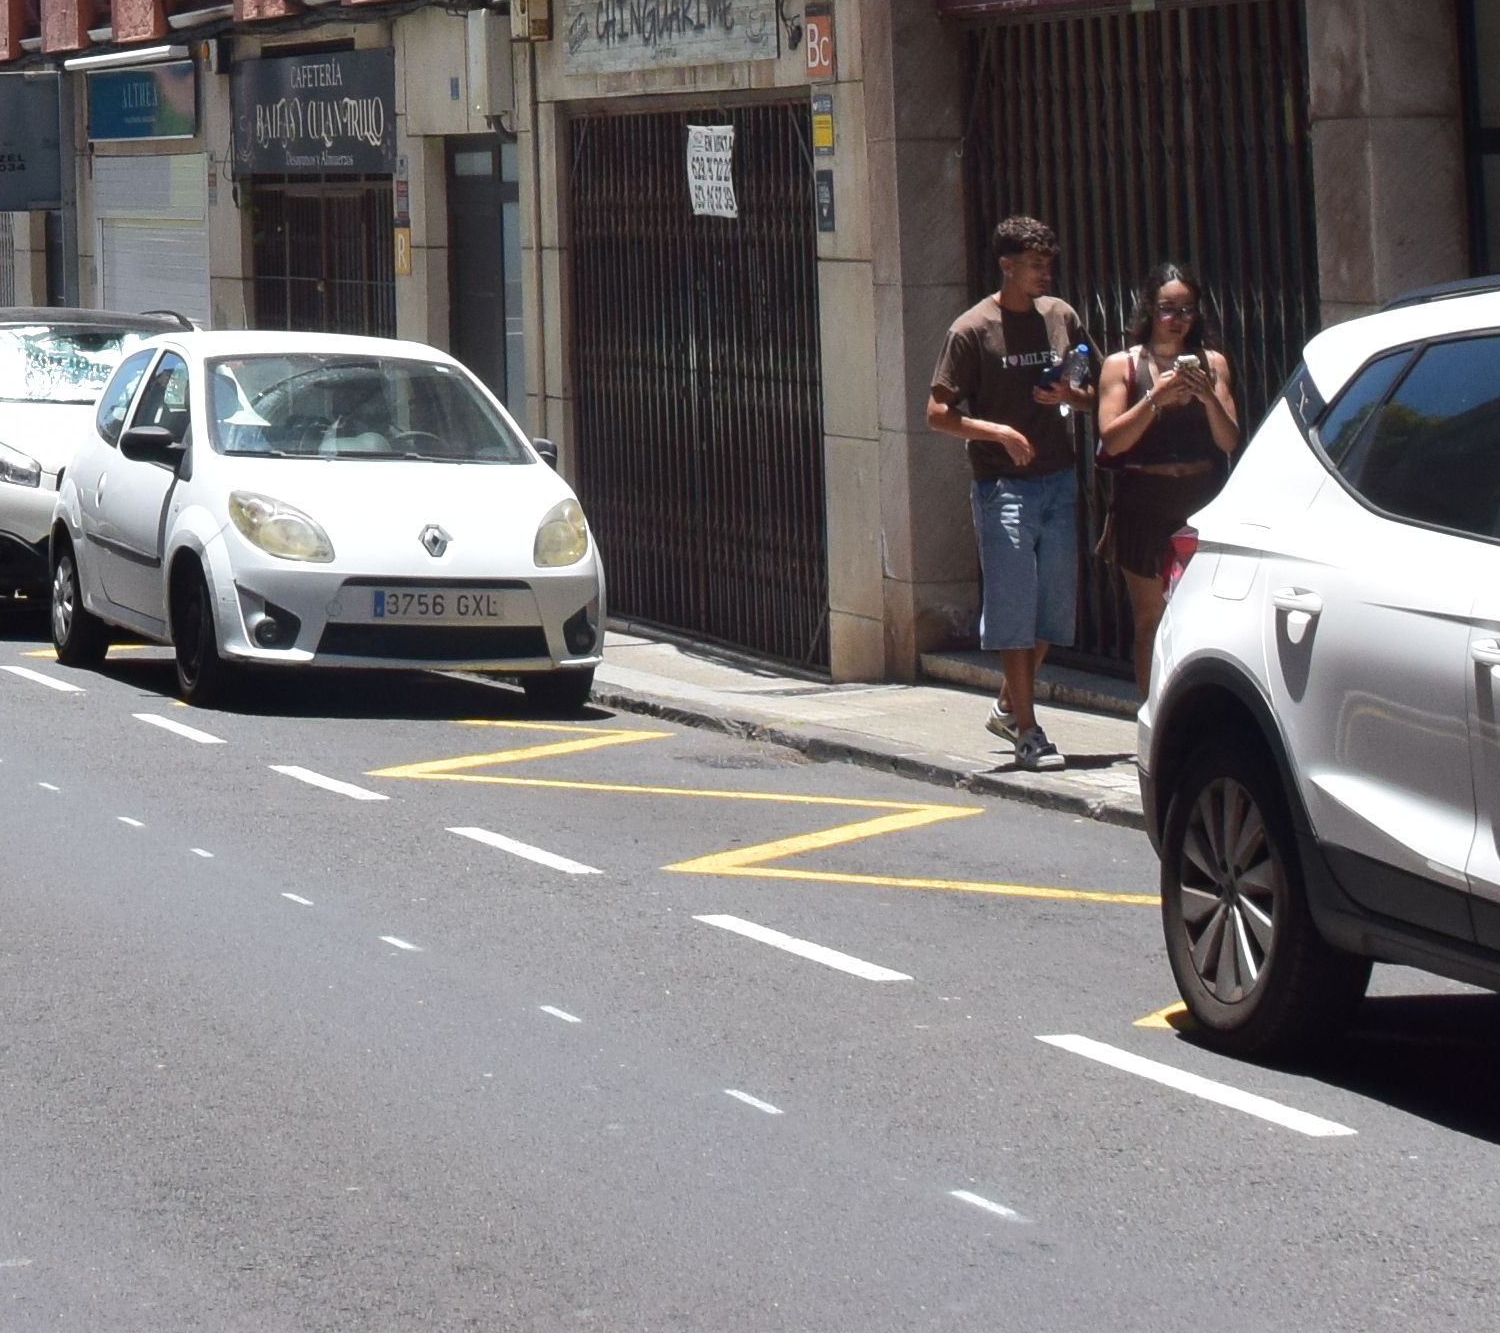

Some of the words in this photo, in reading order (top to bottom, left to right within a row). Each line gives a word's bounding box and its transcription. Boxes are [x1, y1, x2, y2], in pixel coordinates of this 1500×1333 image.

[290, 58, 343, 89] CAFETERÍA
[398, 233, 407, 270] R
[1019, 350, 1058, 367] MILFS
[386, 593, 445, 616] 3756
[456, 594, 499, 617] GXL
